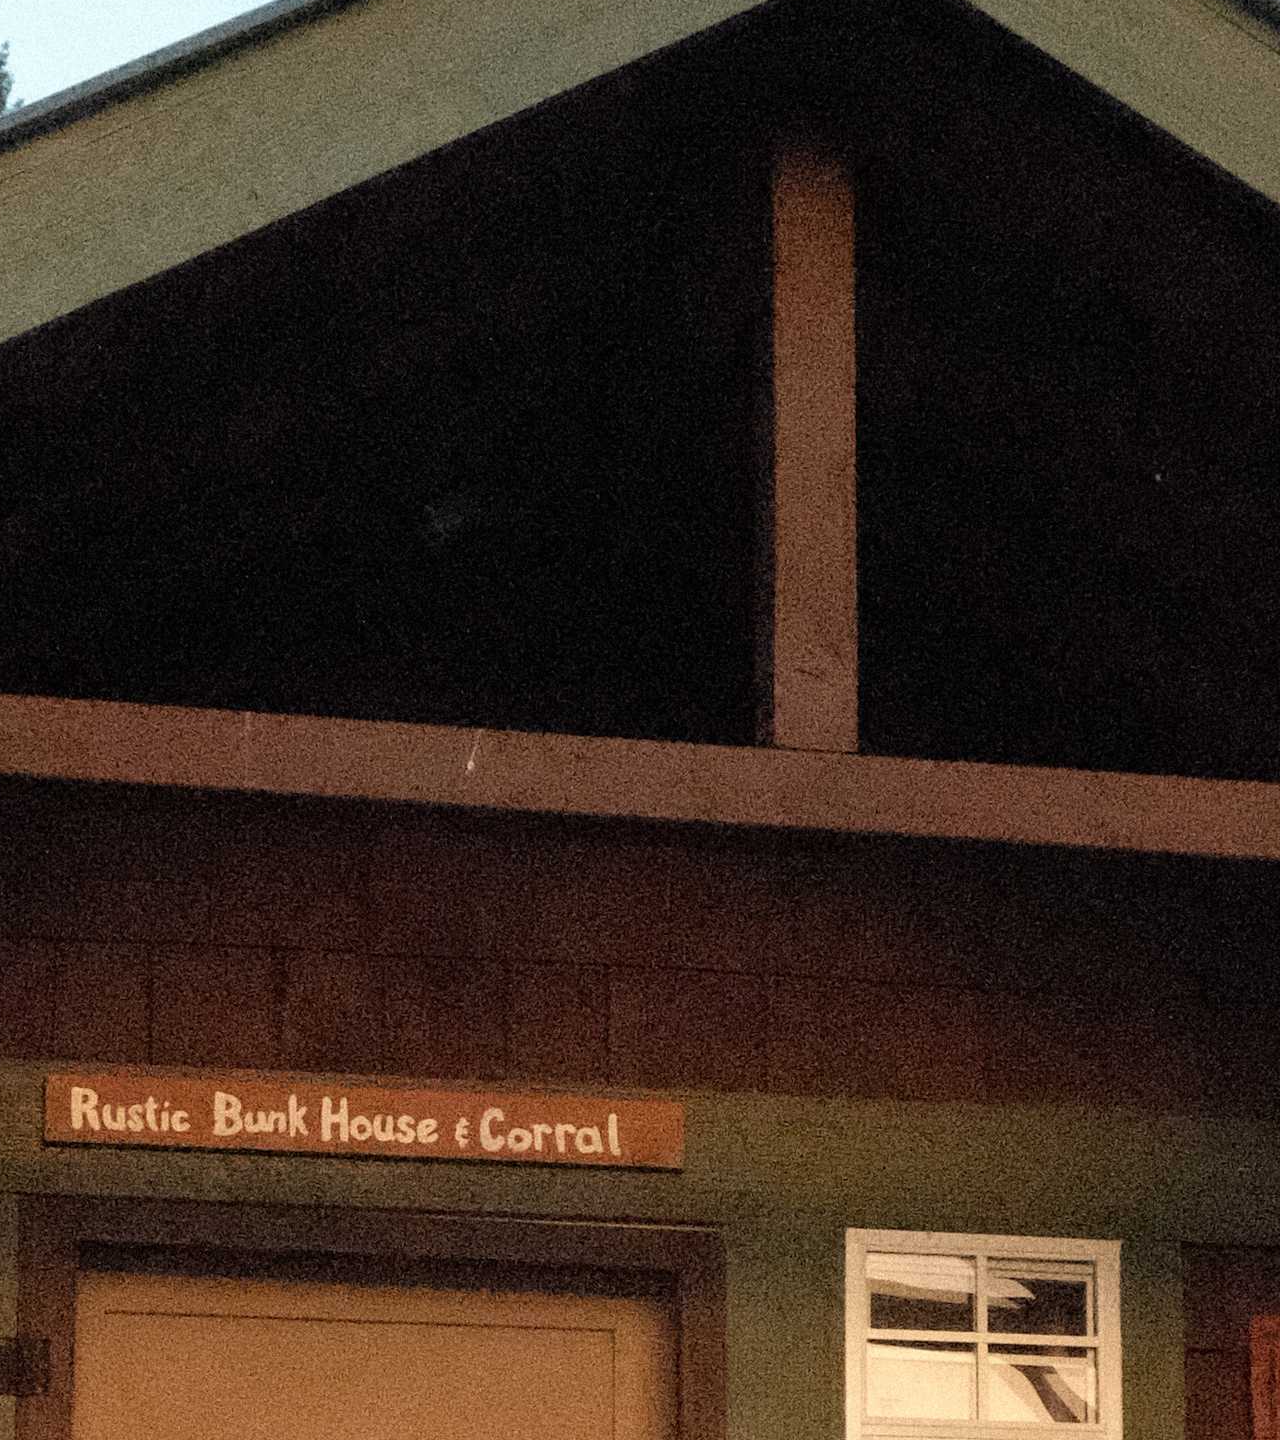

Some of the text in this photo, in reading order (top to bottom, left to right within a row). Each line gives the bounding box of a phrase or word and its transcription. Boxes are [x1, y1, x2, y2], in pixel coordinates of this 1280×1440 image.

[70, 1086, 192, 1133] Rustic
[212, 1091, 309, 1138] Bunk
[321, 1096, 440, 1144] House
[479, 1107, 623, 1157] Corral
